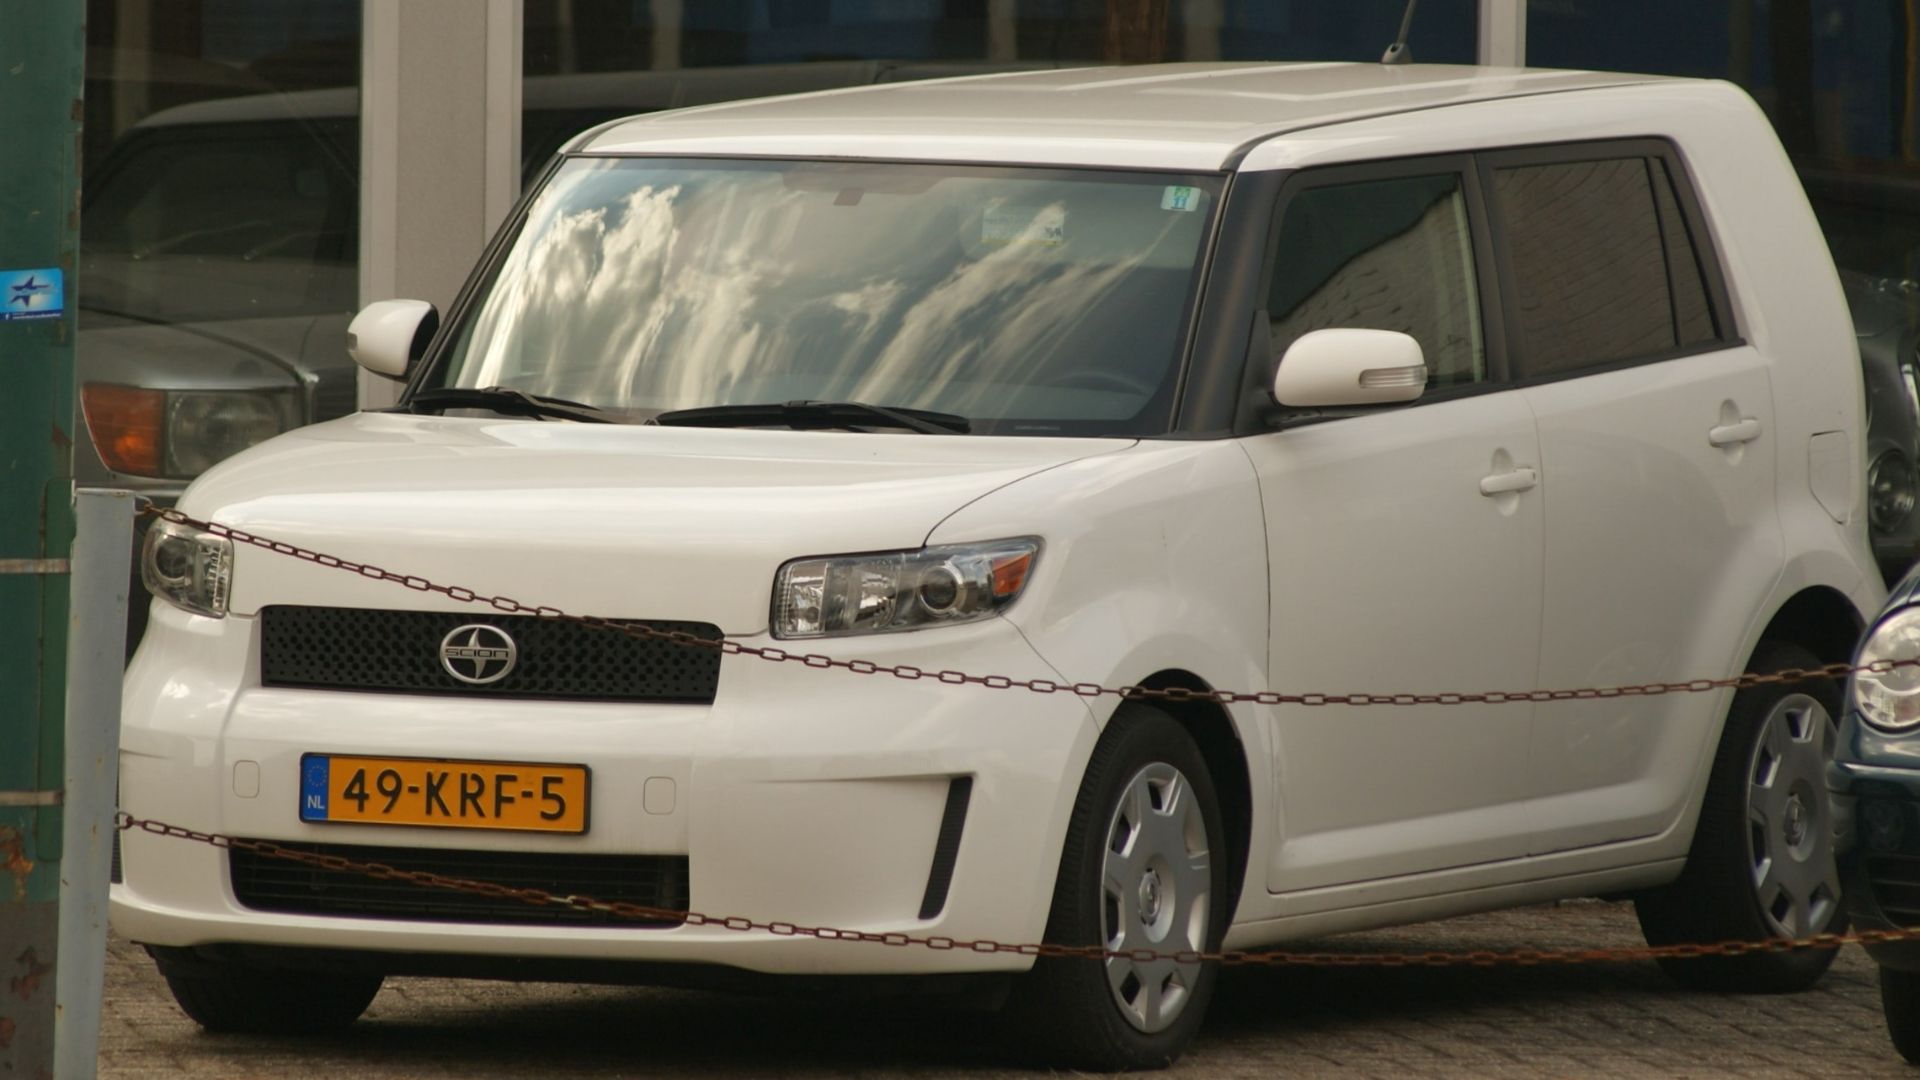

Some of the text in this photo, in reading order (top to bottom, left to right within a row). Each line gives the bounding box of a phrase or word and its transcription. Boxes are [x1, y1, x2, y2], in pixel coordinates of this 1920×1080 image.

[444, 647, 509, 659] SCION
[343, 768, 567, 820] 49-KRF-5
[307, 795, 325, 809] NL
